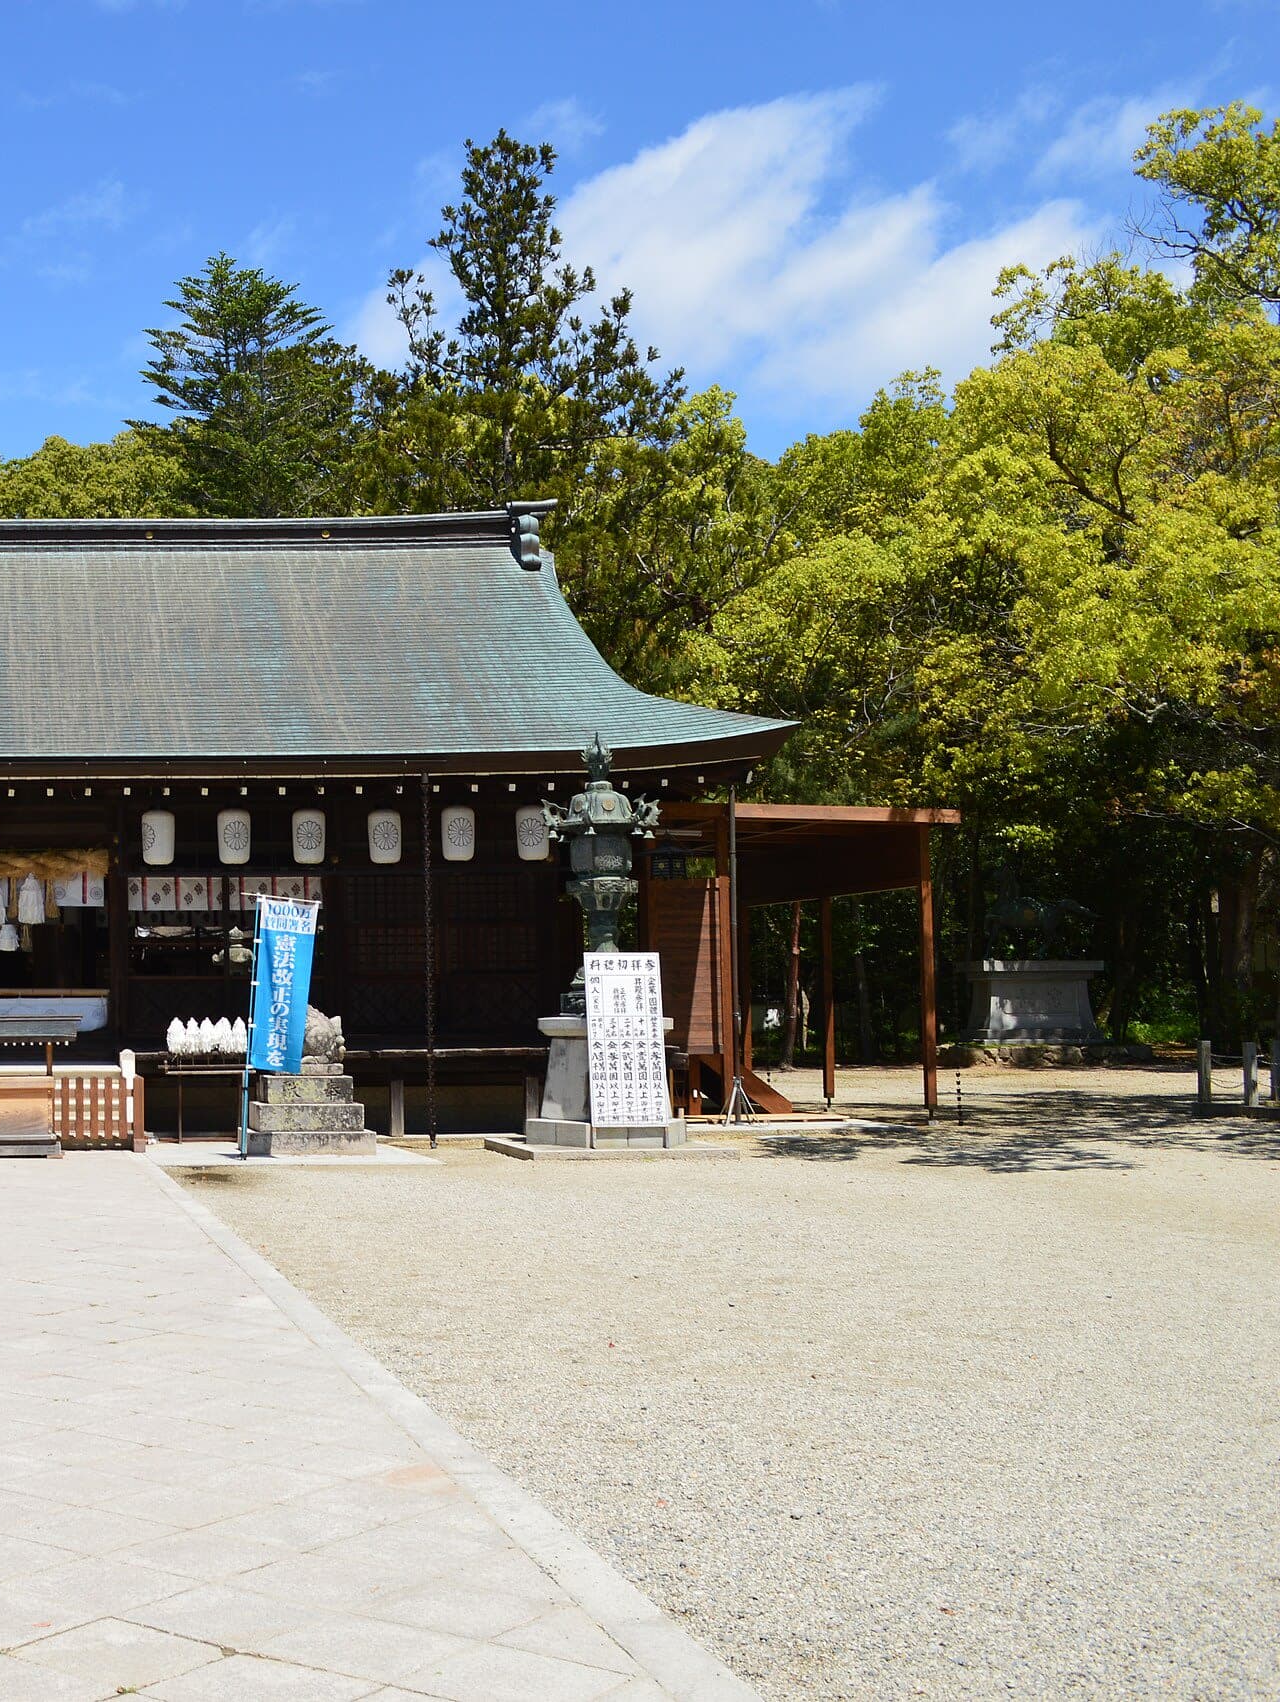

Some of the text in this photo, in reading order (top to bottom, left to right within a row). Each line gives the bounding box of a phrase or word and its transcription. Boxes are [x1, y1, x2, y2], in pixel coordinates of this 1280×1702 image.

[268, 903, 312, 918] 1000万
[266, 934, 297, 1067] 憲法改正の実現を
